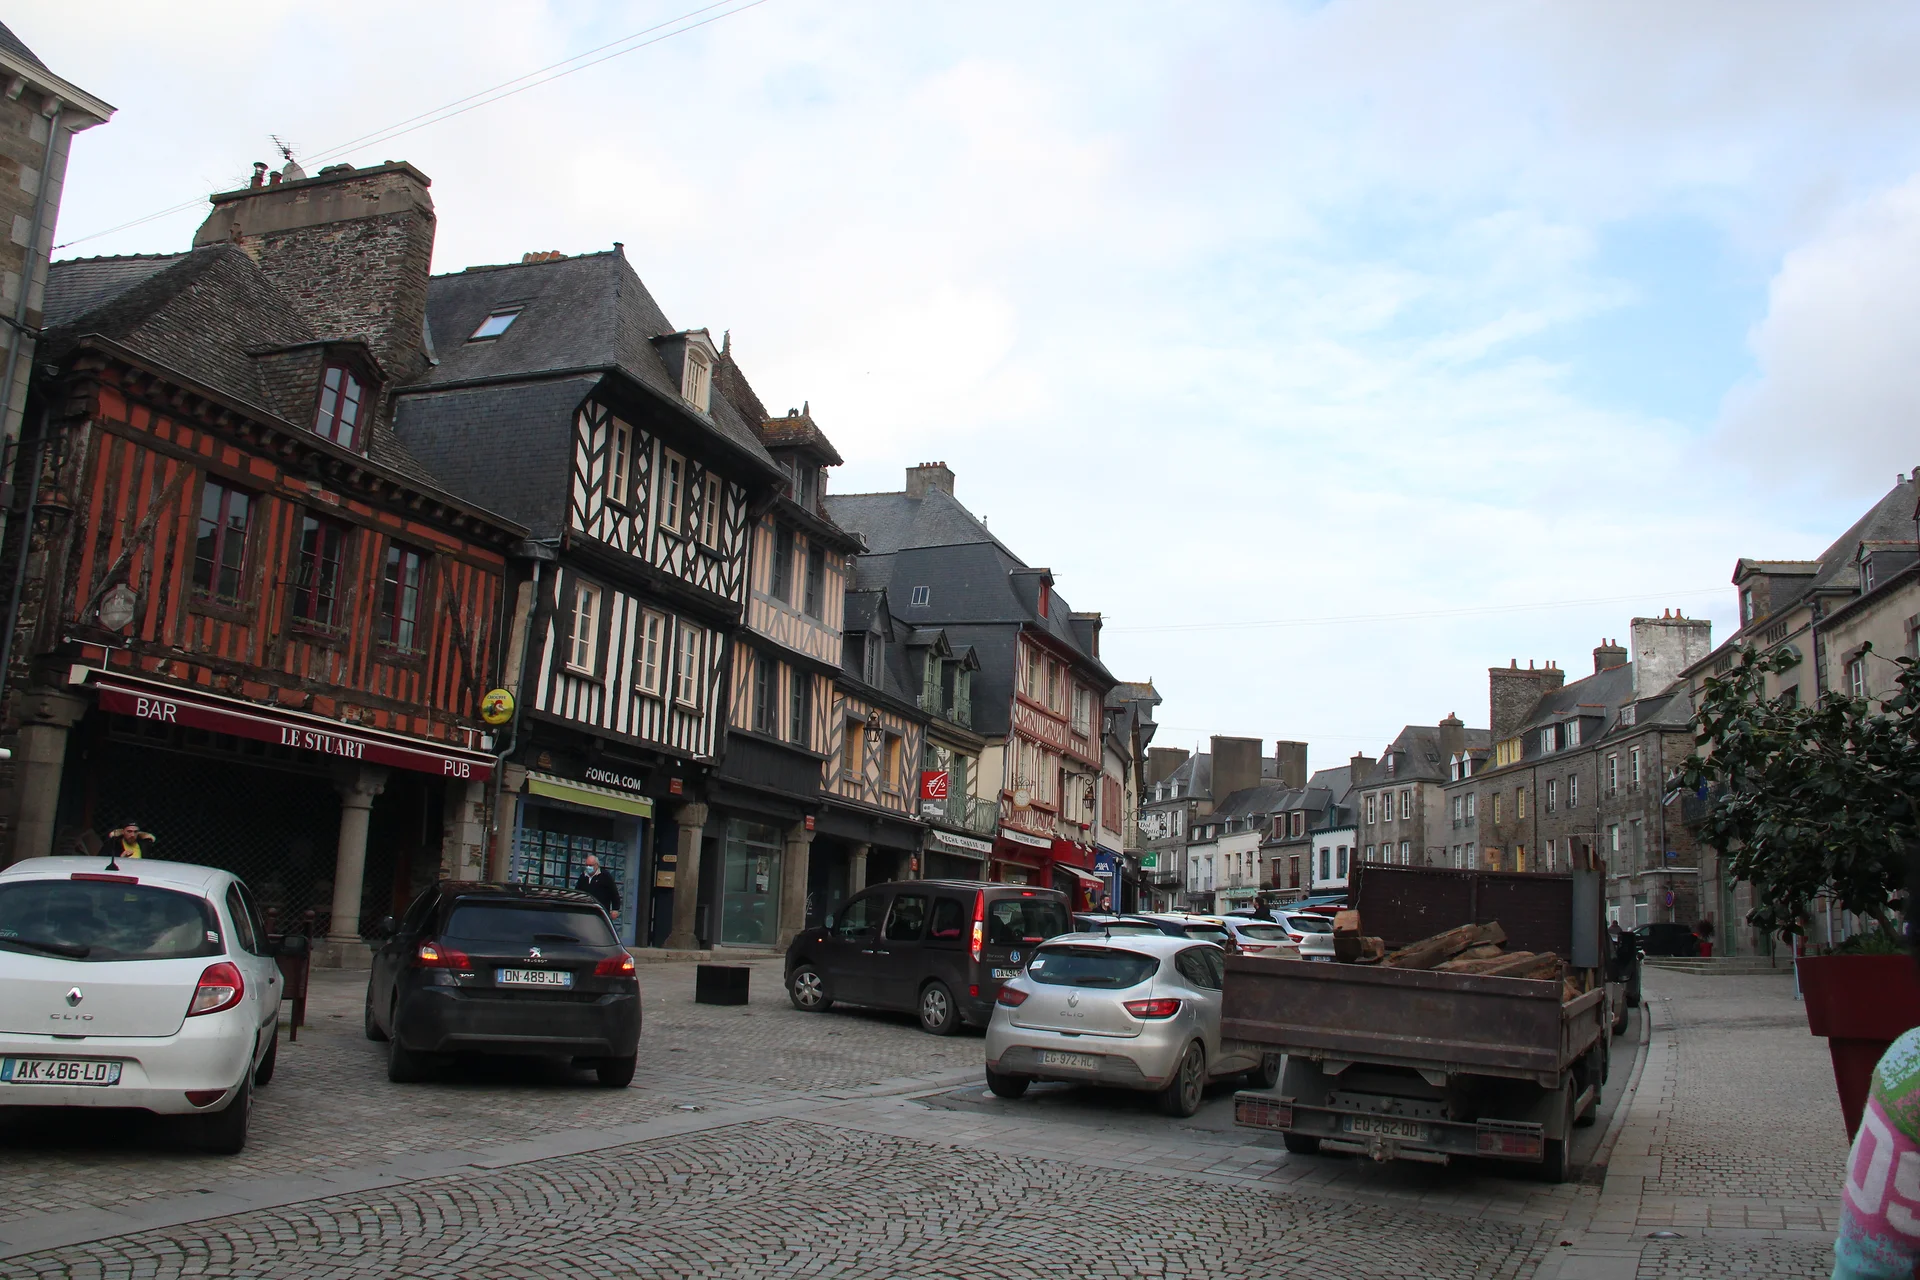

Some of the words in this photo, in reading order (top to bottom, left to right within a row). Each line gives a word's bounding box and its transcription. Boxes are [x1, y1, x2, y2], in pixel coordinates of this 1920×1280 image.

[135, 698, 177, 723] BAR
[281, 727, 301, 747] LE
[304, 733, 366, 760] STUART
[443, 760, 471, 779] PUB
[1095, 862, 1110, 871] AXA
[505, 970, 563, 984] DN-489-JL
[50, 1013, 94, 1021] CLIO
[1044, 1052, 1093, 1067] EG-972-HC
[17, 1061, 107, 1080] AK-486-LD
